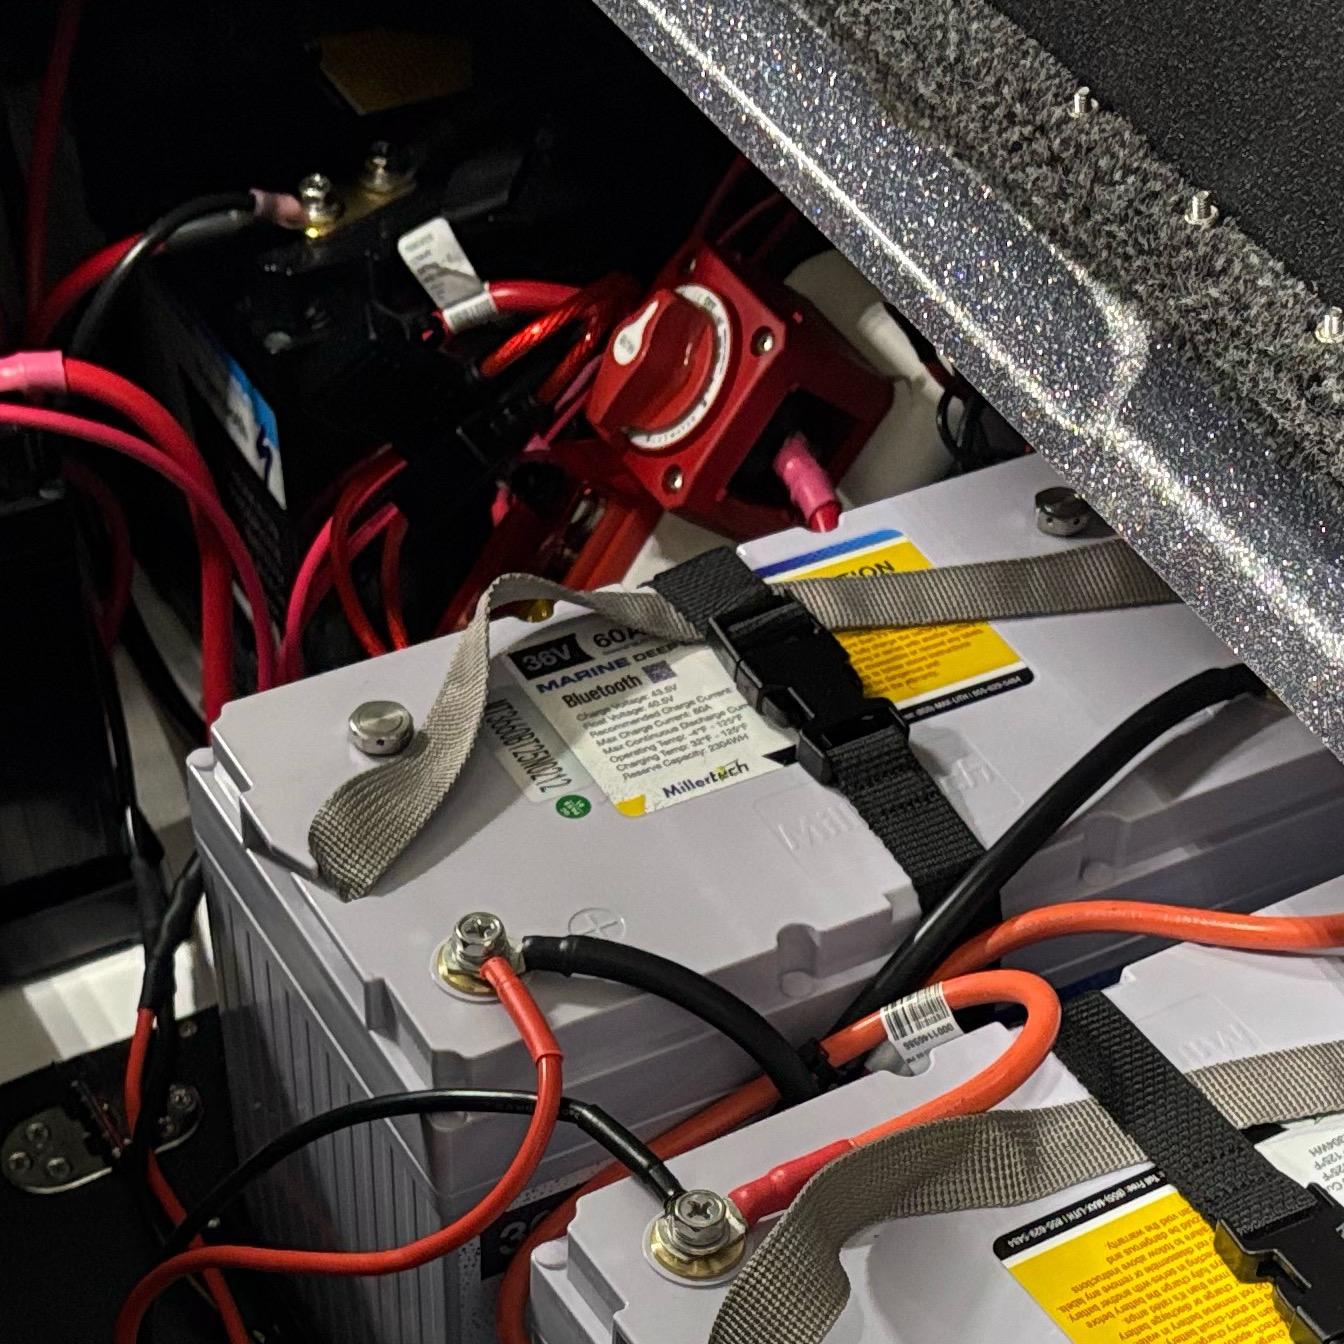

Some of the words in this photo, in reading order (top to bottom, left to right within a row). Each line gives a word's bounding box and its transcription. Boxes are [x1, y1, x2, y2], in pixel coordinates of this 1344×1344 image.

[520, 644, 575, 670] 36V
[537, 658, 628, 692] MARINE
[563, 674, 641, 707] Bluetooth
[590, 711, 659, 737] Recommended
[661, 699, 696, 715] Charge
[595, 735, 617, 746] Max
[618, 723, 654, 740] Charge
[602, 743, 624, 754] Max
[616, 753, 660, 773] Charging
[660, 759, 747, 797] Millertech
